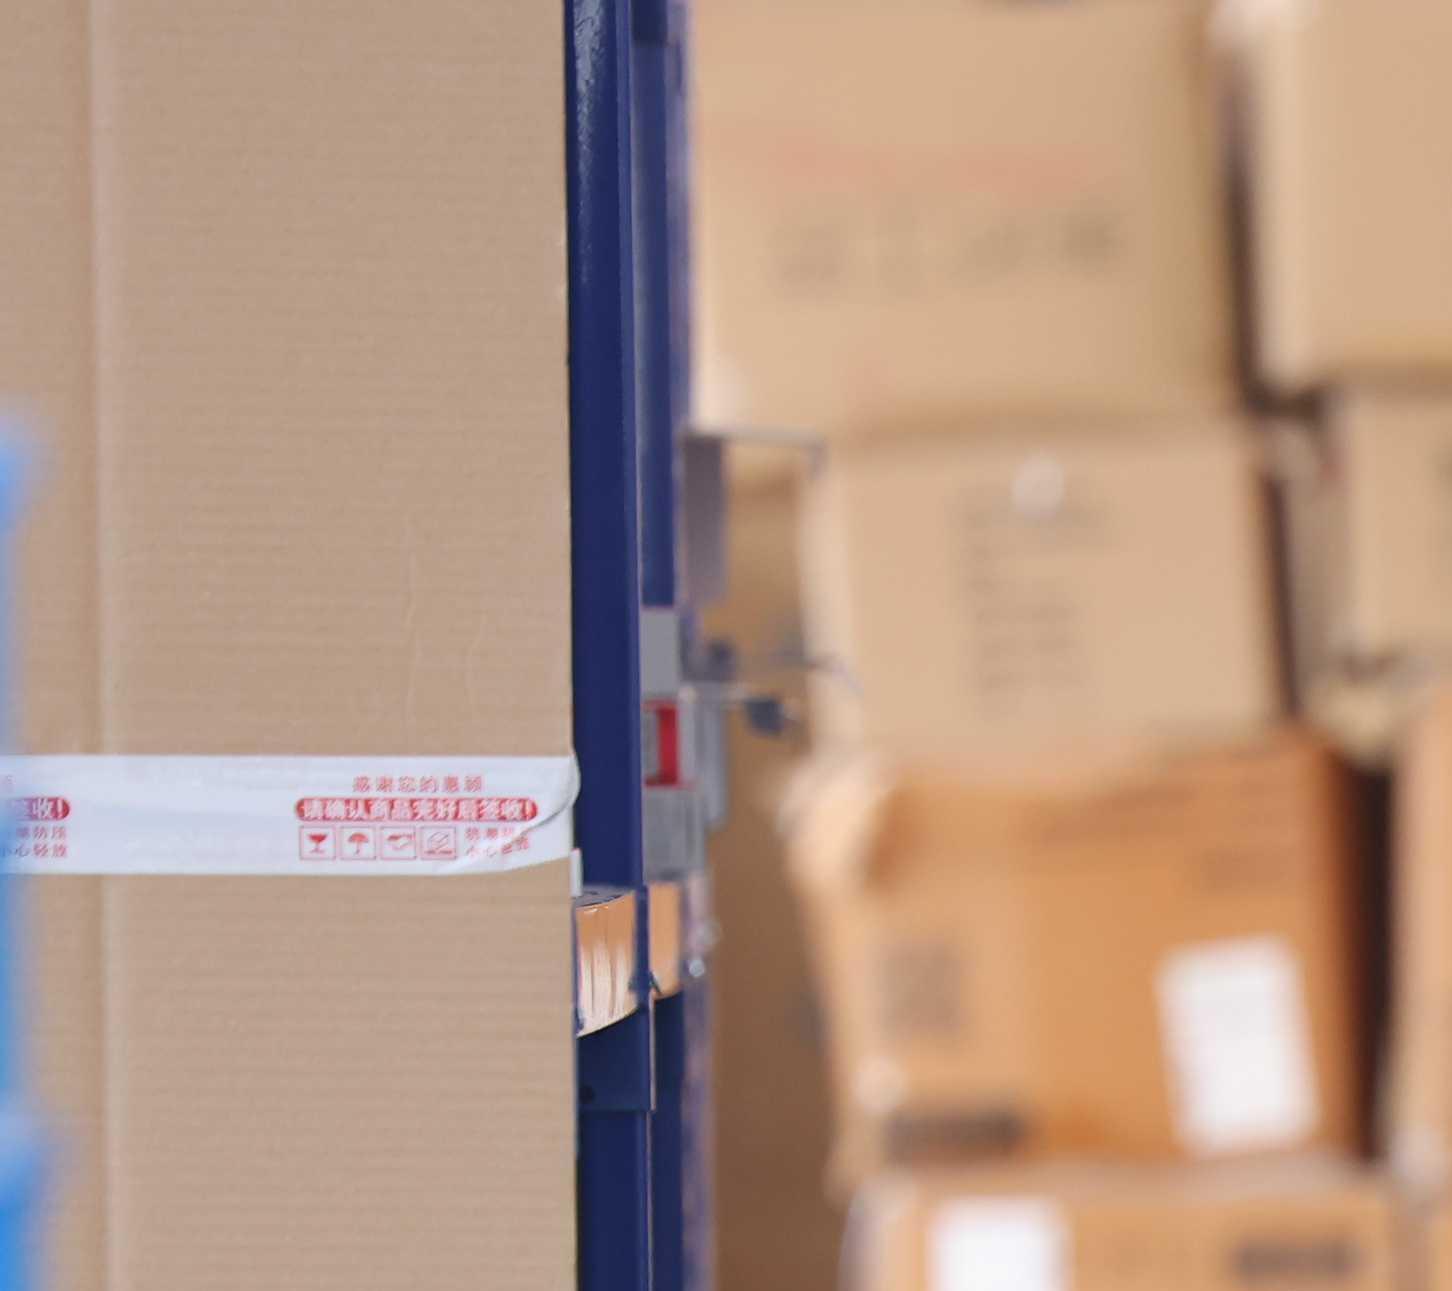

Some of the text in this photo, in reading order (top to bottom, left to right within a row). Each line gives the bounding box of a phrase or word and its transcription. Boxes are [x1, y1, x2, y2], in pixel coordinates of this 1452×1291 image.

[353, 775, 483, 793] 感谢您的惠顾
